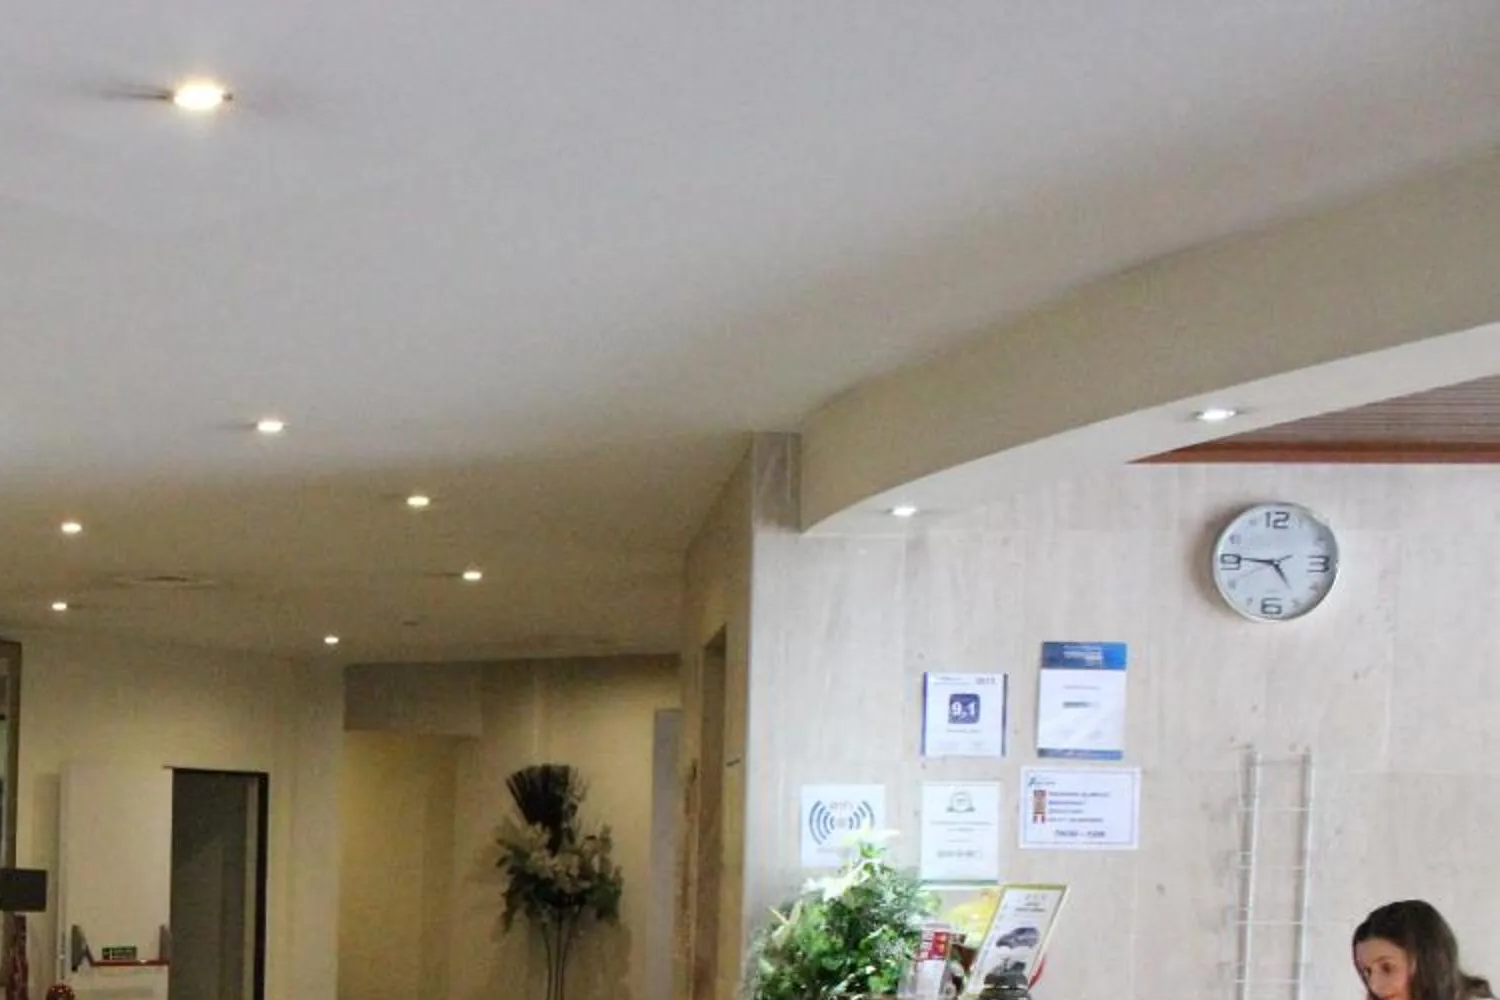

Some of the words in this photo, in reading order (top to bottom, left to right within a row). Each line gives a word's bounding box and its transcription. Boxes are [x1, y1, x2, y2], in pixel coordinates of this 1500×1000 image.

[1264, 511, 1290, 529] 12
[1220, 553, 1241, 571] 9
[1307, 554, 1330, 573] 3
[1260, 597, 1282, 615] 6
